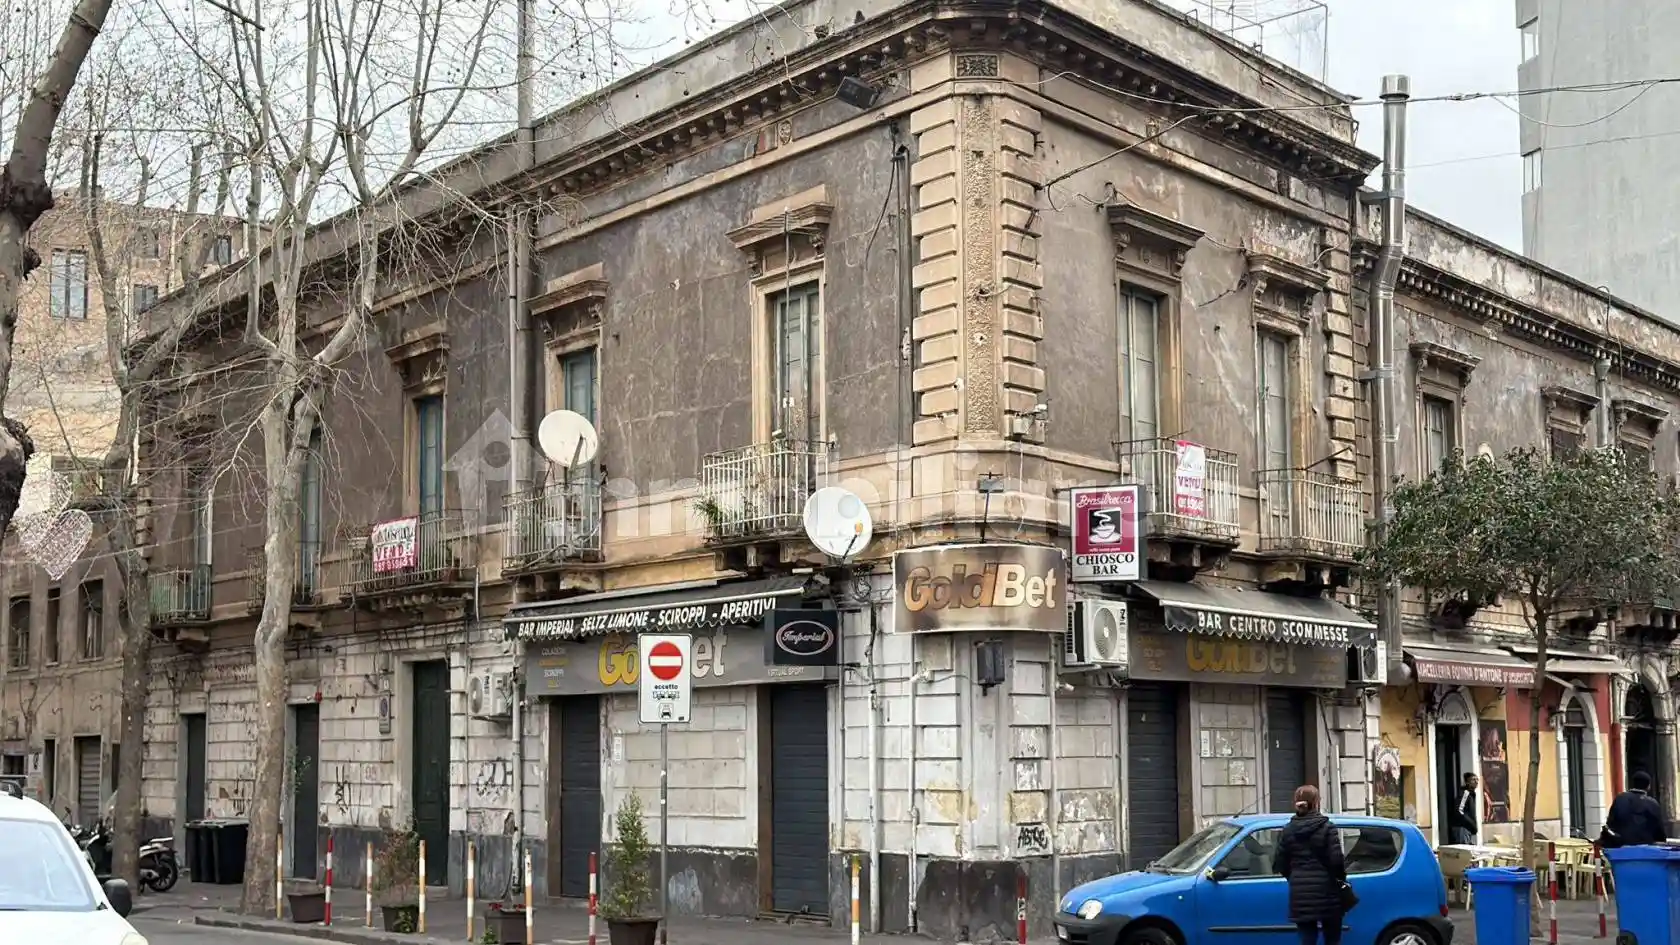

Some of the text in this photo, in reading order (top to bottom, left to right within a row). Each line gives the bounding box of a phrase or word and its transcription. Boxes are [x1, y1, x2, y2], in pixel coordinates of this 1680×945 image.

[1076, 553, 1135, 566] CHIOSCO
[1093, 564, 1118, 575] BAR
[904, 560, 1057, 612] GoldBet
[518, 622, 535, 637] BAR
[536, 618, 575, 636] IMPERIAL
[580, 614, 607, 633] SELTZ
[607, 611, 650, 629] LIMONE
[657, 605, 707, 626] SCIROPPI
[720, 597, 777, 620] APERITIVI
[1197, 610, 1349, 642] BAR CENTRO SCOMMESSE
[782, 630, 827, 645] Imperial
